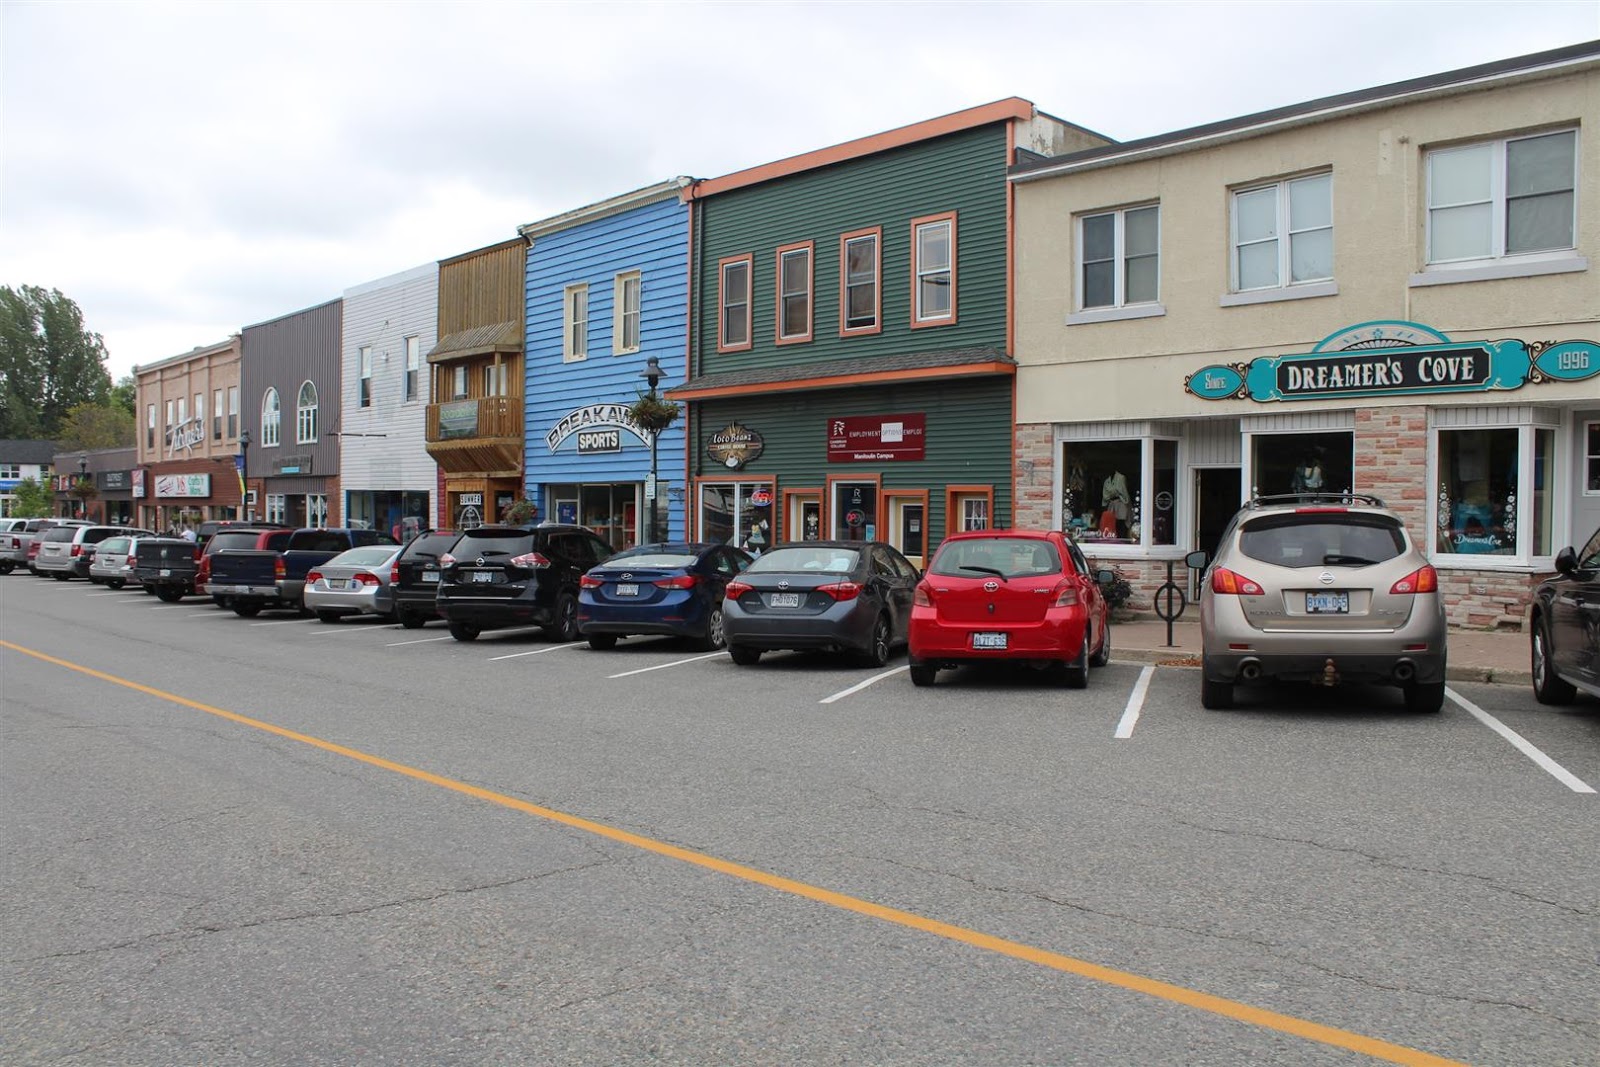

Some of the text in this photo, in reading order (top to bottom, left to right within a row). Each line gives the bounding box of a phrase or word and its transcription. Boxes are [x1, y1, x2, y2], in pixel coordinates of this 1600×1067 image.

[1558, 351, 1589, 370] 1996
[1287, 356, 1475, 390] DREAMER'S COVE
[549, 406, 652, 448] BREAKAW
[849, 429, 881, 438] EMPLOYMENT
[579, 431, 618, 449] SPORTS
